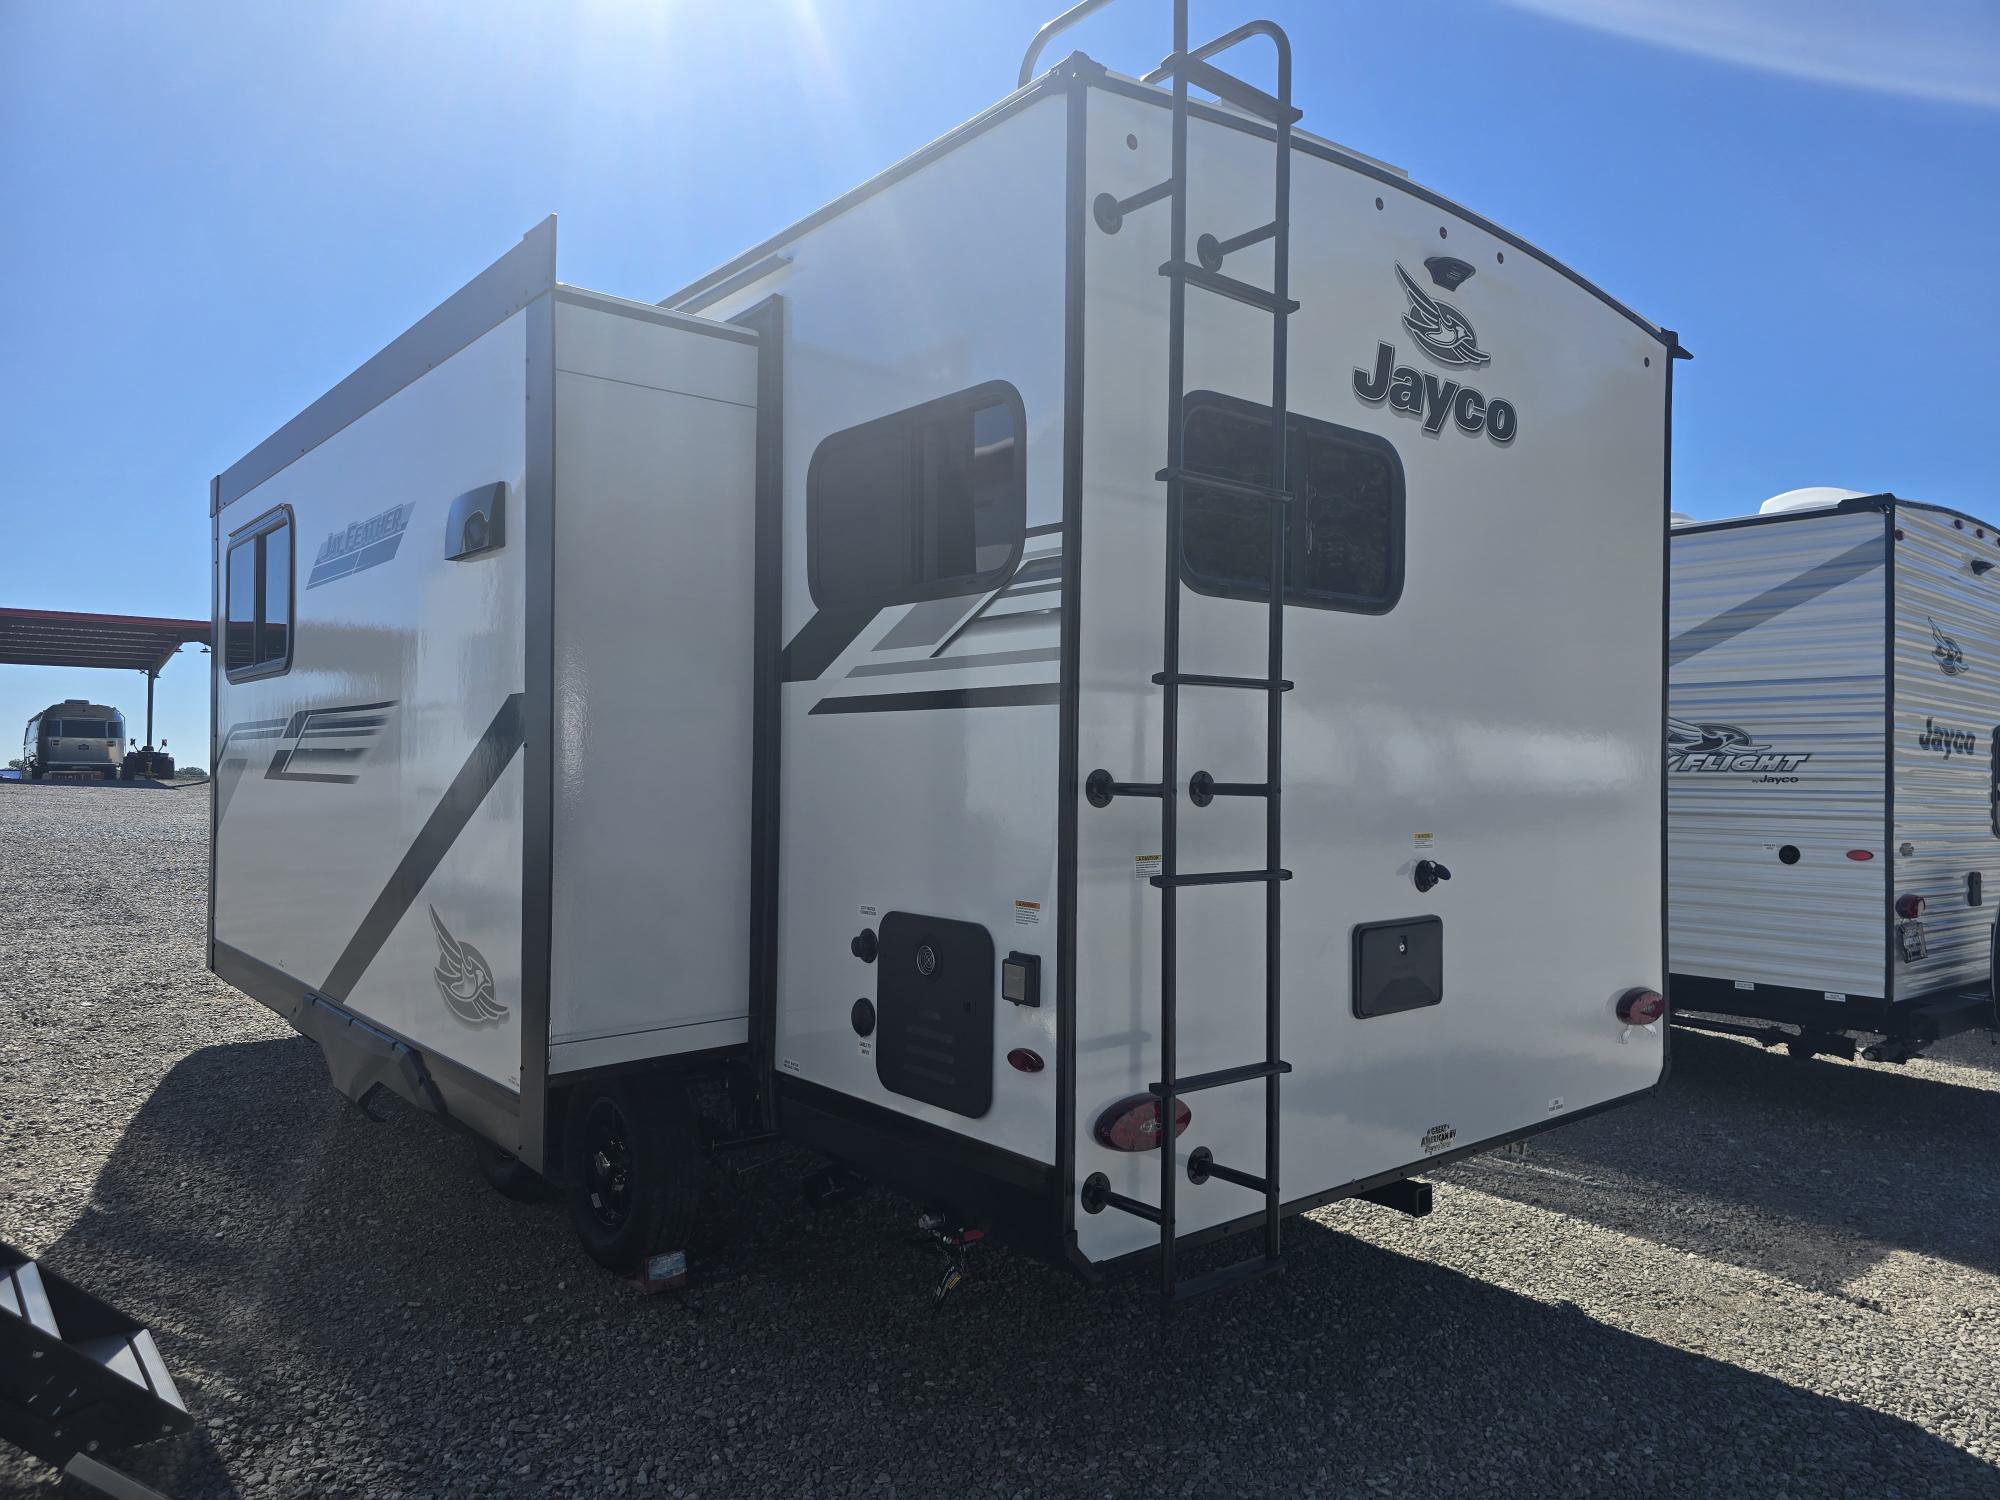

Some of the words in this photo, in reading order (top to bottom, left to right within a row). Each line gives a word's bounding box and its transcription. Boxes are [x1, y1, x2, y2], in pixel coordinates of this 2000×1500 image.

[1353, 339, 1518, 442] Jayco
[345, 503, 404, 553] FEATHER
[1919, 716, 1976, 761] Jayco
[1675, 752, 1811, 773] FLIGHT
[1759, 774, 1799, 785] Jayco
[1420, 1132, 1449, 1148] AMERICAN
